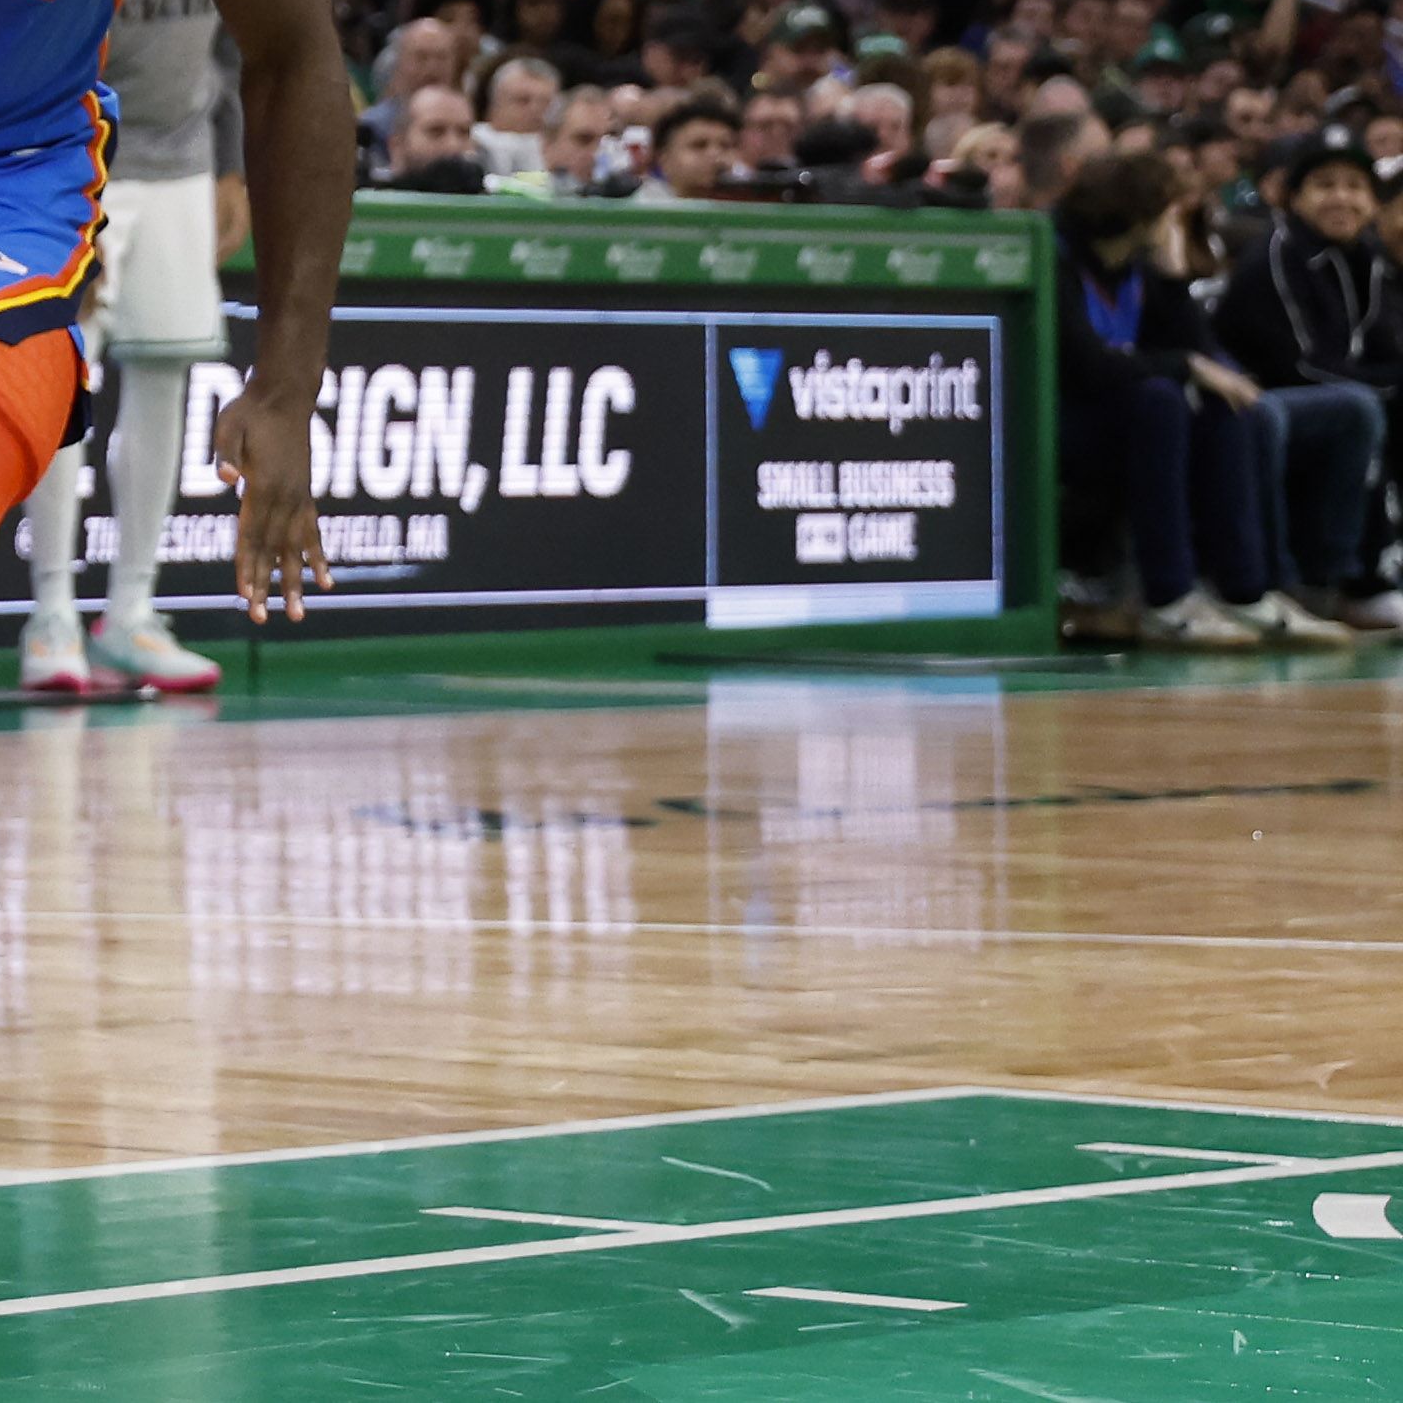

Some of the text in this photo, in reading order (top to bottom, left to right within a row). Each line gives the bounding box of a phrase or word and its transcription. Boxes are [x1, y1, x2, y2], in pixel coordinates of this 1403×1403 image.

[179, 361, 488, 514] DSIGN,
[499, 364, 637, 498] LLC
[789, 348, 983, 436] vistaprint
